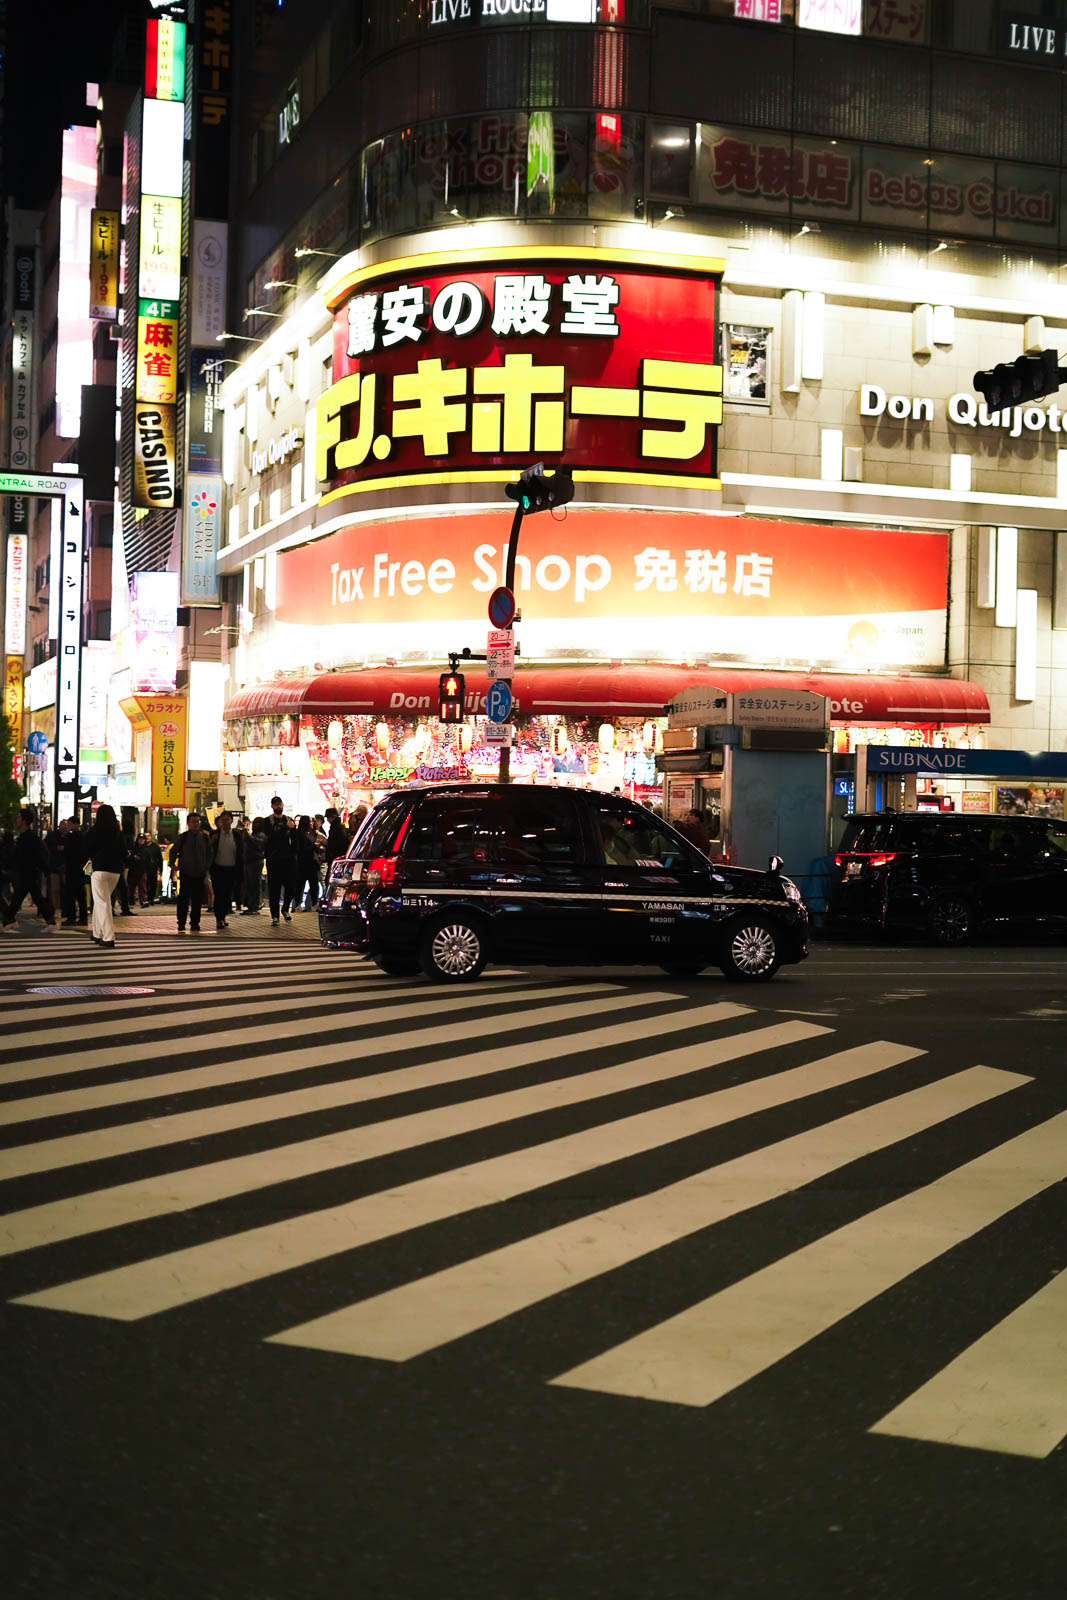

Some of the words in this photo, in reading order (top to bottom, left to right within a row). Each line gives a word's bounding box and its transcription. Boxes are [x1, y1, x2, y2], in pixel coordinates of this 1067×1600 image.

[1009, 23, 1056, 54] LIVE
[712, 137, 849, 203] 免税店
[867, 168, 961, 211] Bebas
[967, 181, 1052, 221] Cukai
[98, 216, 110, 260] 生ビール
[152, 203, 164, 255] 生ビール
[146, 302, 171, 317] 4F
[346, 274, 620, 358] 驚安の殿堂
[144, 322, 173, 377] 麻雀
[859, 384, 935, 421] Don
[137, 411, 173, 500] CASINO
[38, 480, 68, 490] ROAD
[330, 562, 365, 606] Tax
[373, 553, 456, 598] Free
[471, 543, 612, 603] Shop
[633, 547, 774, 598] 免税店
[146, 703, 184, 713] カラオケ
[390, 692, 430, 709] Don
[739, 698, 820, 711] 安全安心ステーション
[370, 766, 415, 781] Happy
[879, 751, 967, 769] SUBNADE
[642, 902, 685, 911] YAMASAN
[650, 935, 671, 943] TAXI
